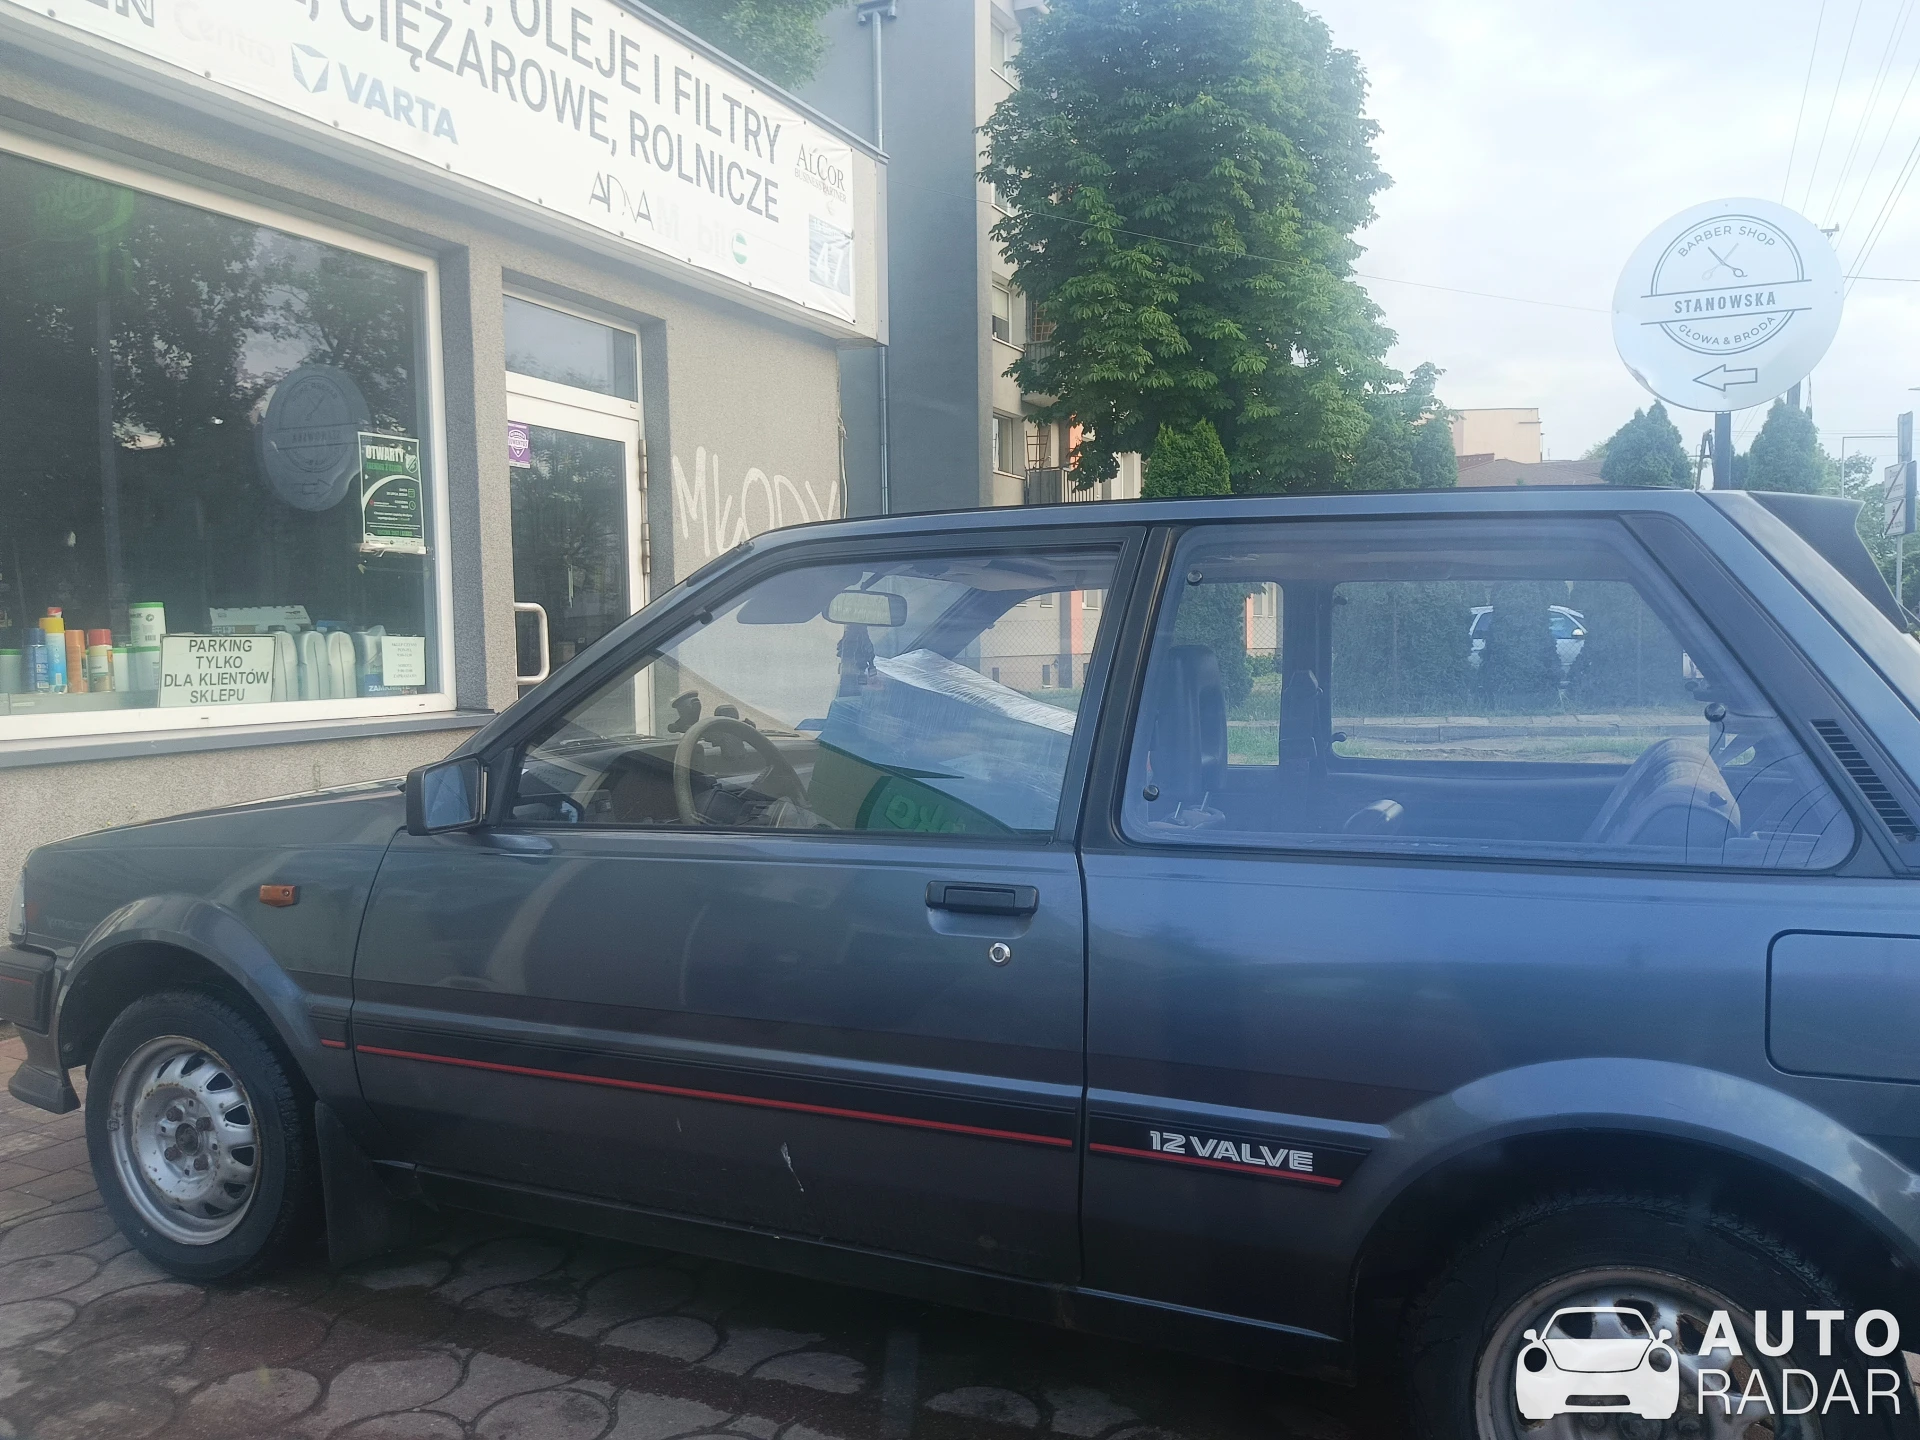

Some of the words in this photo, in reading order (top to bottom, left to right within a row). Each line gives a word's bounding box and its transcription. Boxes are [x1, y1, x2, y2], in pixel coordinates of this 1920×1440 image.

[511, 0, 641, 95] OLEJE
[654, 54, 661, 105] I
[674, 65, 782, 165] FILTRY
[338, 61, 459, 146] VARTA
[629, 109, 779, 223] ROLNICZE
[1677, 225, 1733, 258] BARBER
[1738, 225, 1776, 247] SHOP
[1674, 291, 1777, 314] STANOWSKA
[1678, 323, 1720, 346] GŁOWA
[1722, 336, 1731, 345] &
[1733, 315, 1777, 344] BRODA
[189, 639, 253, 653] PARKING
[195, 655, 243, 669] TYLKO
[164, 673, 193, 688] DLA
[199, 668, 270, 686] KLIENTÓW
[189, 688, 245, 704] SKLEPU
[1149, 1130, 1187, 1154] 12
[1189, 1135, 1314, 1172] VALVE
